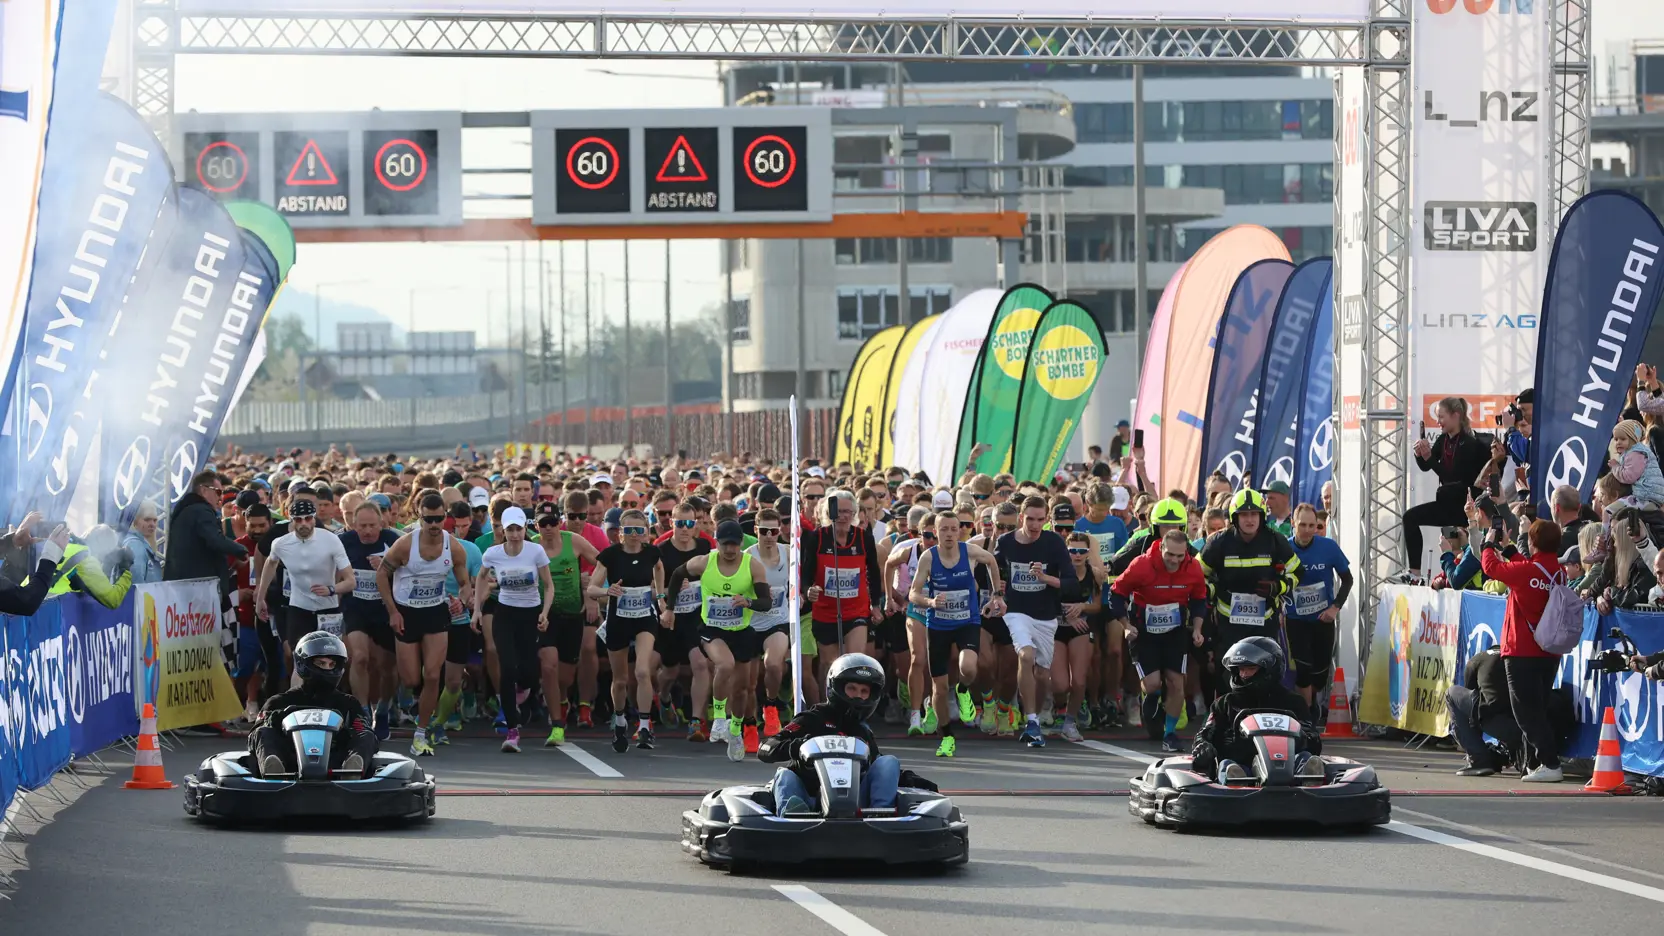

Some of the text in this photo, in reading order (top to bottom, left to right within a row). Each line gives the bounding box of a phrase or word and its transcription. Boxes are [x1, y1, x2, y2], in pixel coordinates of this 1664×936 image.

[207, 156, 236, 179] 60
[385, 154, 415, 177] 60
[576, 151, 607, 175] 60
[754, 150, 784, 174] 60
[277, 194, 347, 213] ABSTAND
[648, 191, 717, 209] ABSTAND
[1433, 207, 1529, 230] LIVA
[1433, 231, 1529, 246] SPORT
[36, 141, 149, 372] HYUNDAI
[141, 232, 230, 426] HYUNDAI
[1423, 313, 1536, 328] LINZ AG
[1572, 238, 1659, 429] HYUNDAI
[188, 271, 262, 434] HYUNDAI
[1033, 345, 1098, 366] SCHARTNER
[1048, 363, 1085, 380] BOMBE
[622, 598, 647, 607] 11849
[712, 608, 738, 617] 12250
[1237, 604, 1259, 614] 9933
[1152, 615, 1173, 624] 8561
[184, 647, 214, 673] DONAU
[167, 678, 215, 708] MARATHON
[302, 711, 323, 723] 73
[1262, 716, 1284, 729] 52
[824, 739, 848, 751] 64
